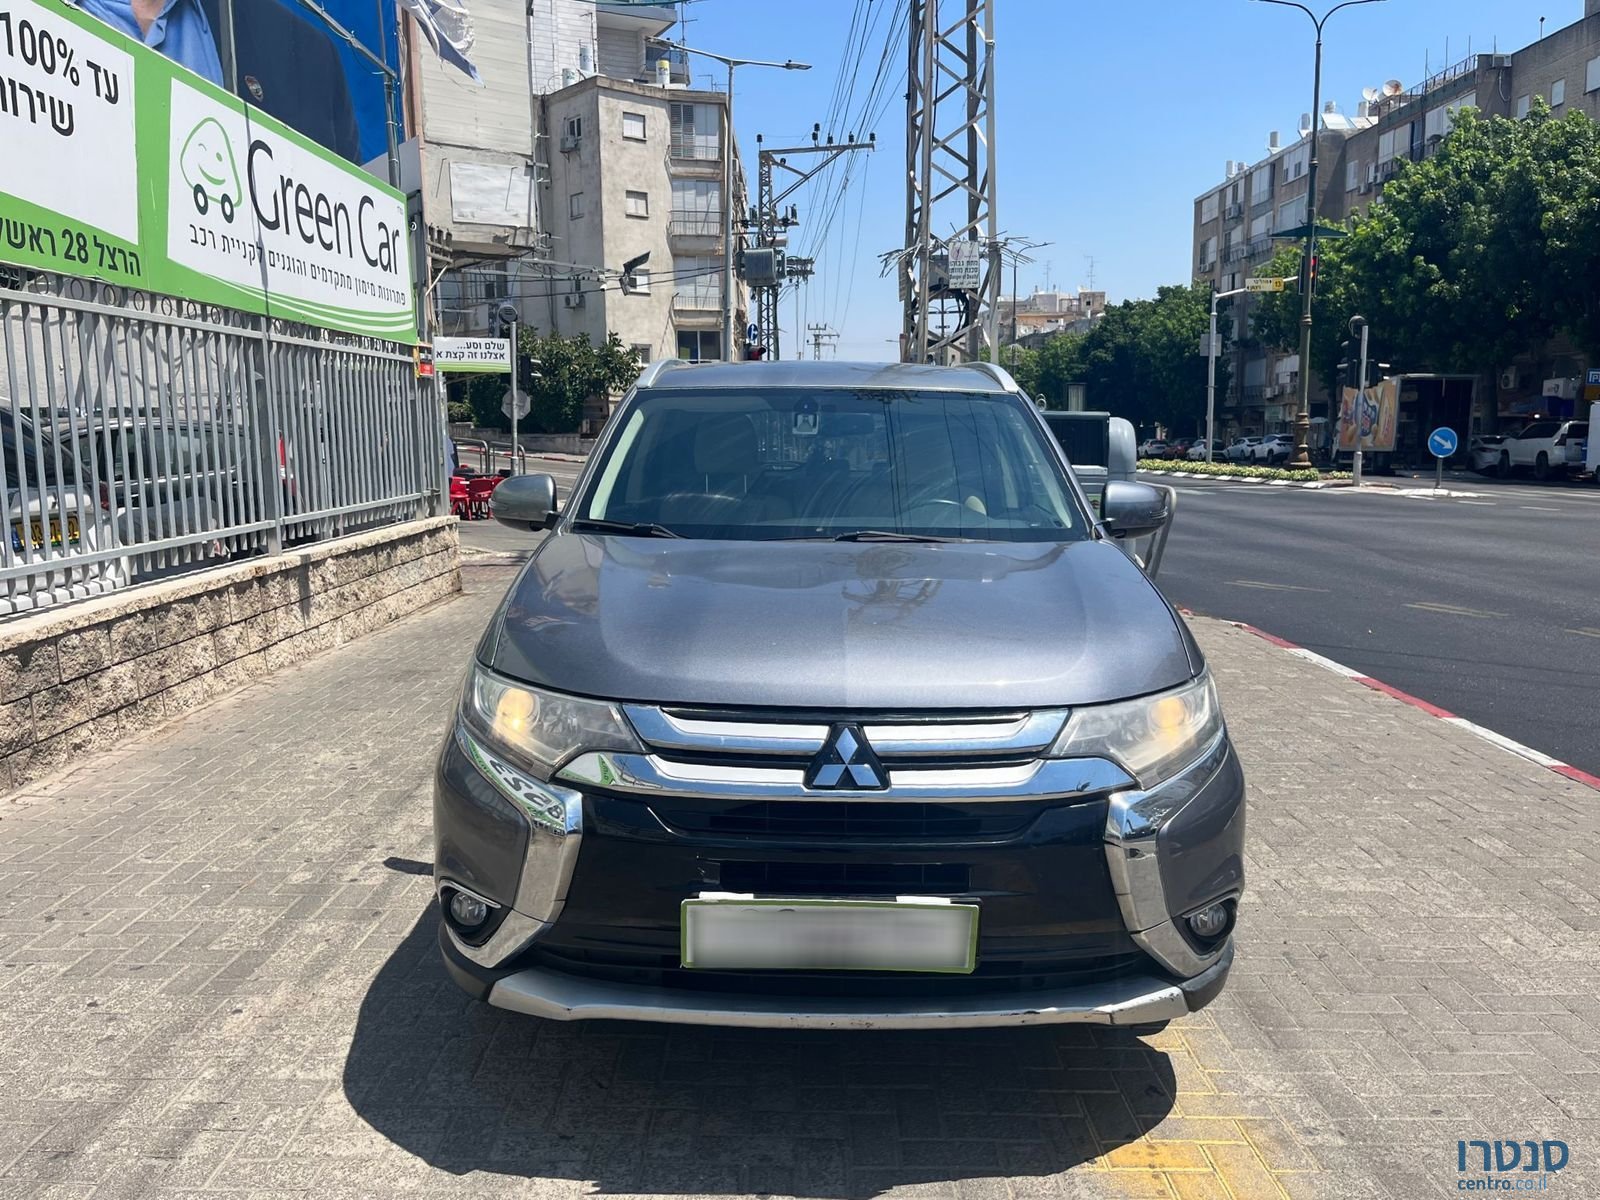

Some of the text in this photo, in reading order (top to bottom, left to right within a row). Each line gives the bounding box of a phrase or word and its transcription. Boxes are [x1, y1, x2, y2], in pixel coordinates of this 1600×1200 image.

[0, 11, 119, 105] עד 100%
[247, 139, 400, 275] Green Car
[61, 228, 89, 264] 28
[189, 223, 217, 250] רכב
[221, 234, 263, 266] לקניית
[93, 234, 141, 277] הרצל
[268, 250, 307, 277] והוגנים
[310, 263, 353, 291] מתקדמים
[354, 277, 376, 297] מימון
[445, 351, 465, 361] קצת
[457, 341, 505, 351] שלם וסע...
[467, 351, 478, 359] זה
[480, 351, 506, 361] אצלנו
